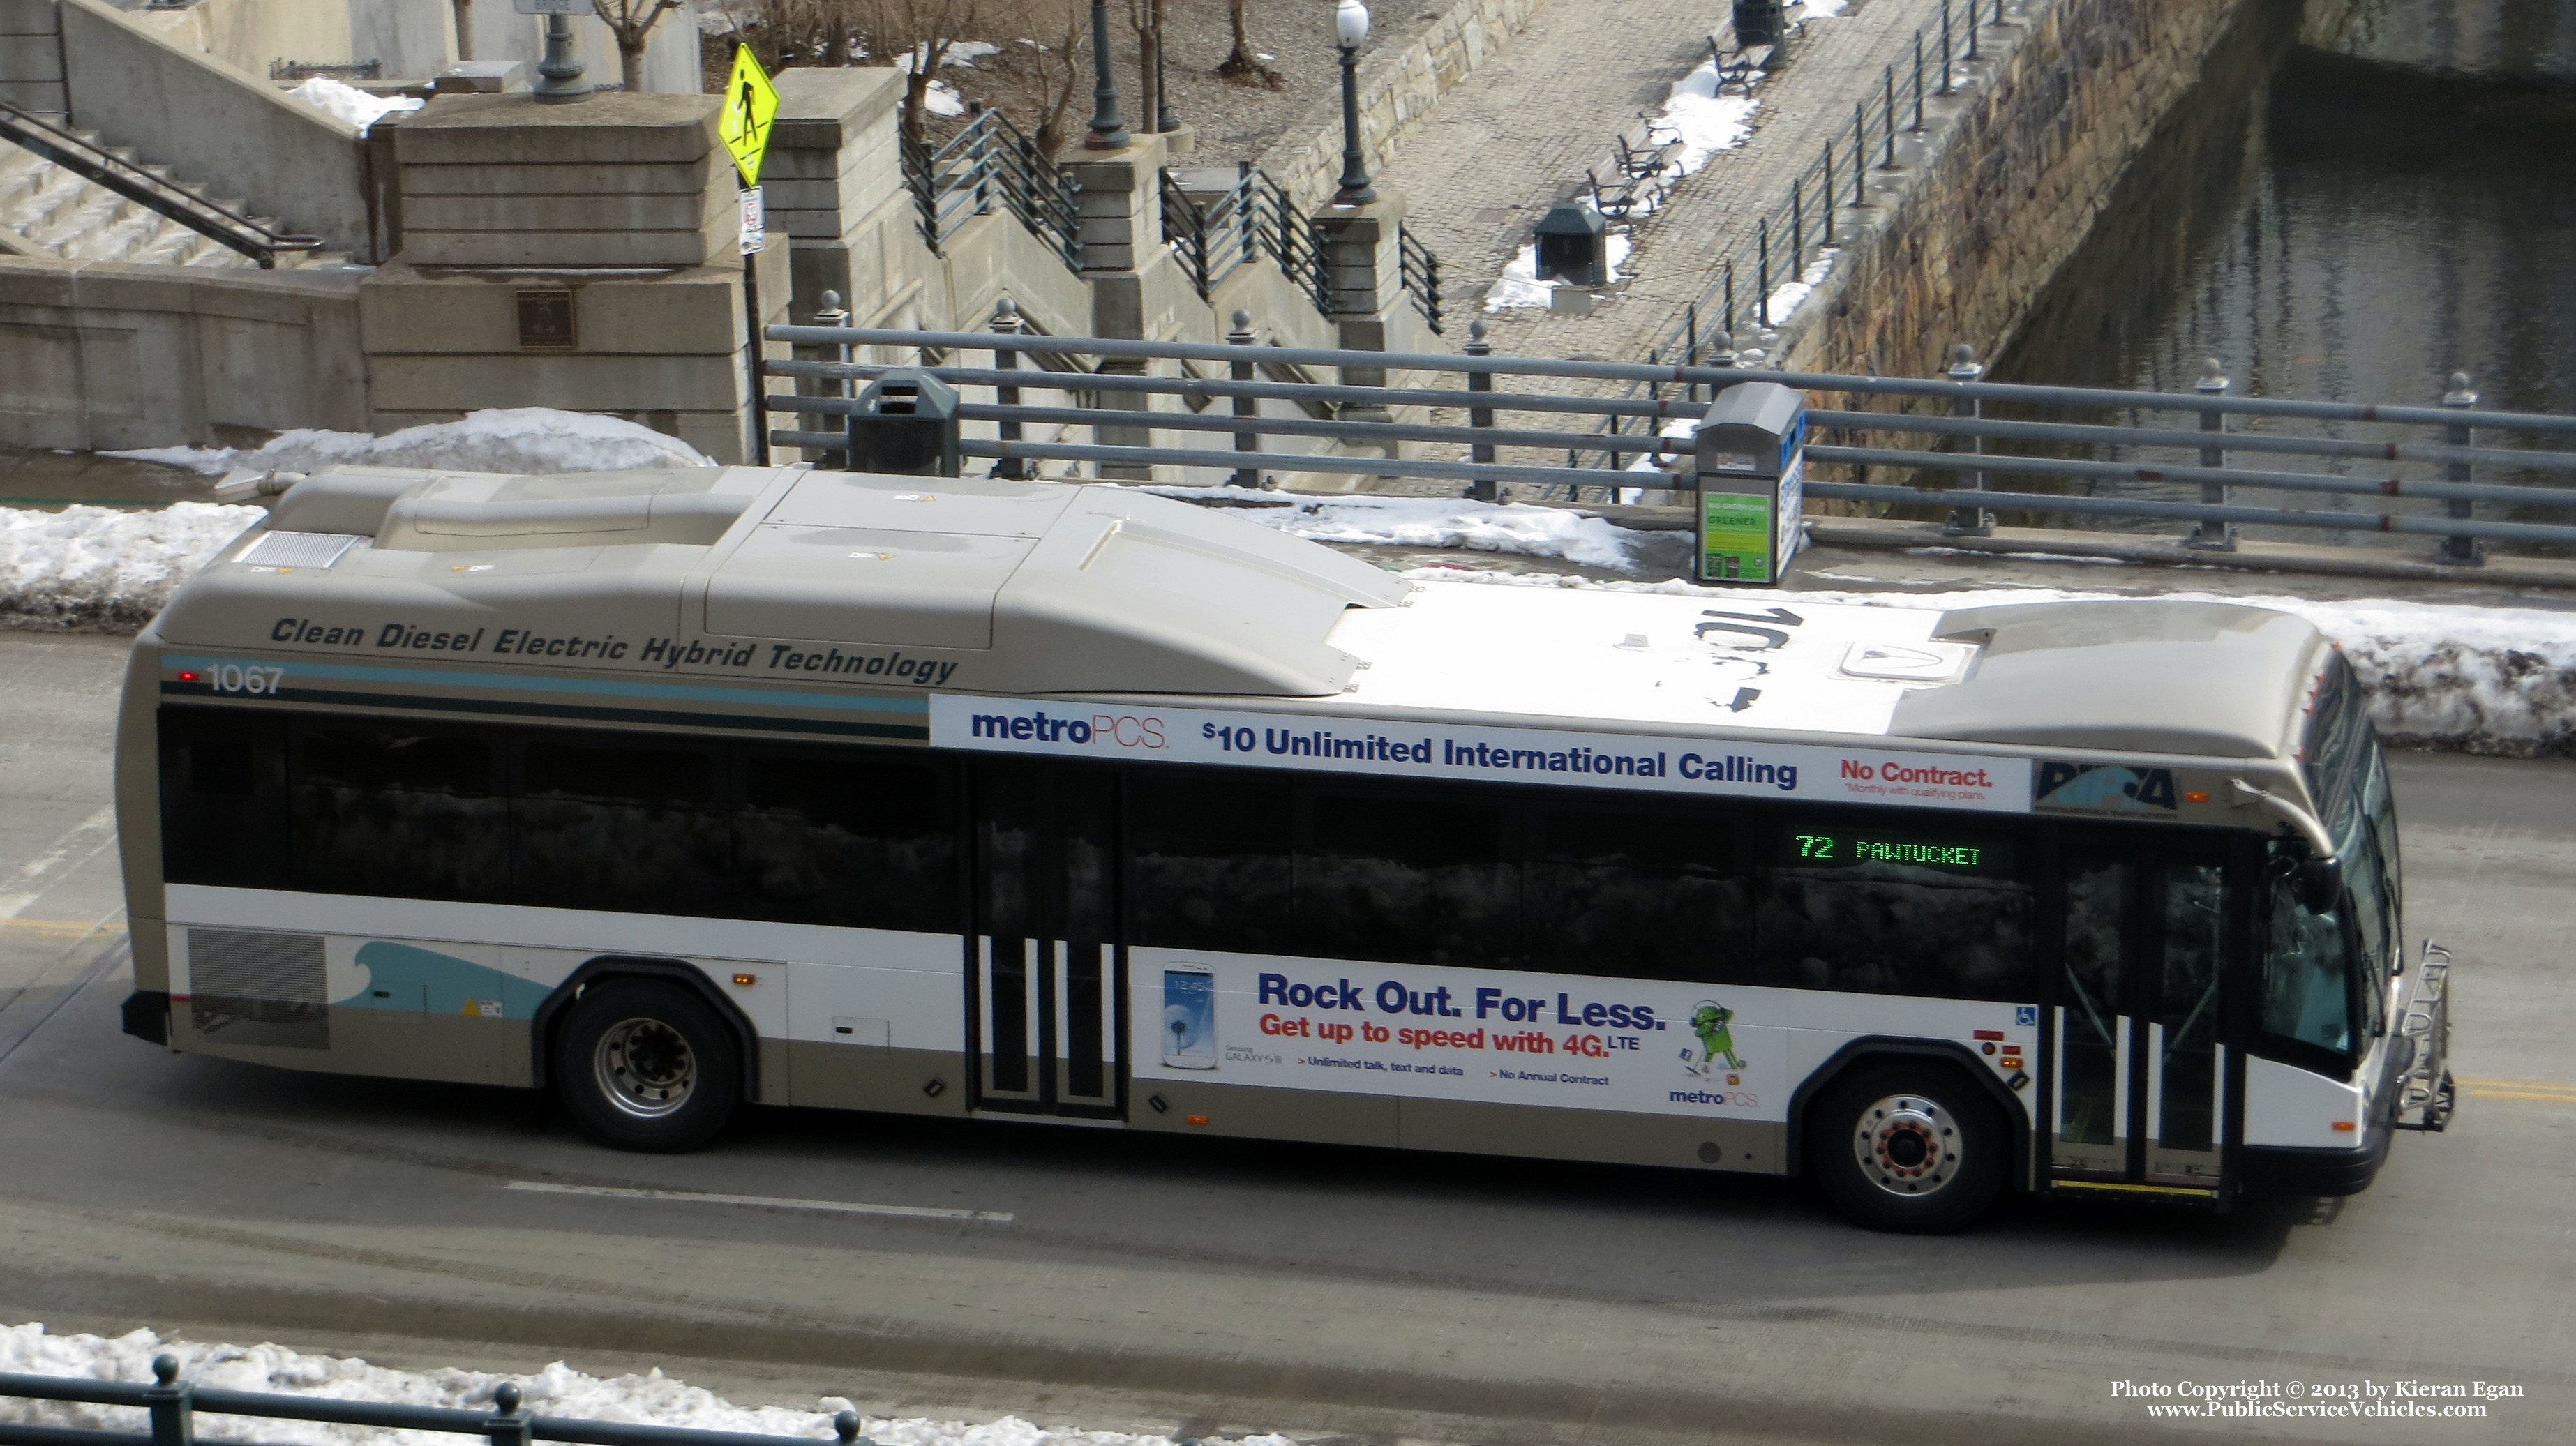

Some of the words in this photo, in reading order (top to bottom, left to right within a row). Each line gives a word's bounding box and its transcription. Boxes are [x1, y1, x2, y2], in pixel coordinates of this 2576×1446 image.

[1708, 515, 1756, 526] GREENER
[271, 618, 365, 646] Clean
[376, 623, 484, 652] Diesel
[493, 628, 628, 659] Electric
[641, 638, 756, 669] Hybrid
[768, 645, 957, 684] Technology
[207, 664, 284, 694] 1067
[1202, 721, 1256, 752] $10
[1266, 728, 1432, 764] Unlimited
[1444, 739, 1665, 778] International
[1679, 752, 1797, 790] Calling
[1841, 759, 1874, 780] No
[1881, 762, 1993, 788] Contract.
[1889, 786, 1910, 795] with
[1912, 788, 1956, 800] qualifying
[1959, 790, 1986, 800] plans.
[1796, 835, 1833, 859] 72
[1857, 841, 1979, 865] PAWTUCKET
[1259, 973, 1365, 1011] Rock
[1376, 981, 1462, 1018] Out.
[1476, 987, 1546, 1022] For
[1557, 993, 1666, 1030] Less.
[1260, 1014, 1310, 1037] Get
[1318, 1023, 1354, 1044] up
[1361, 1021, 1389, 1043] to
[1398, 1027, 1484, 1050] speed
[1492, 1031, 1554, 1054] with
[1226, 1052, 1263, 1062] GALAXY
[1308, 1056, 1361, 1069] Unlimited
[1364, 1060, 1387, 1073] talk,
[1391, 1062, 1411, 1074] text
[1414, 1063, 1436, 1075] and
[1438, 1065, 1464, 1076] data
[1499, 1069, 1515, 1080] No
[1518, 1071, 1557, 1083] Annual
[1560, 1074, 1610, 1086] Contract
